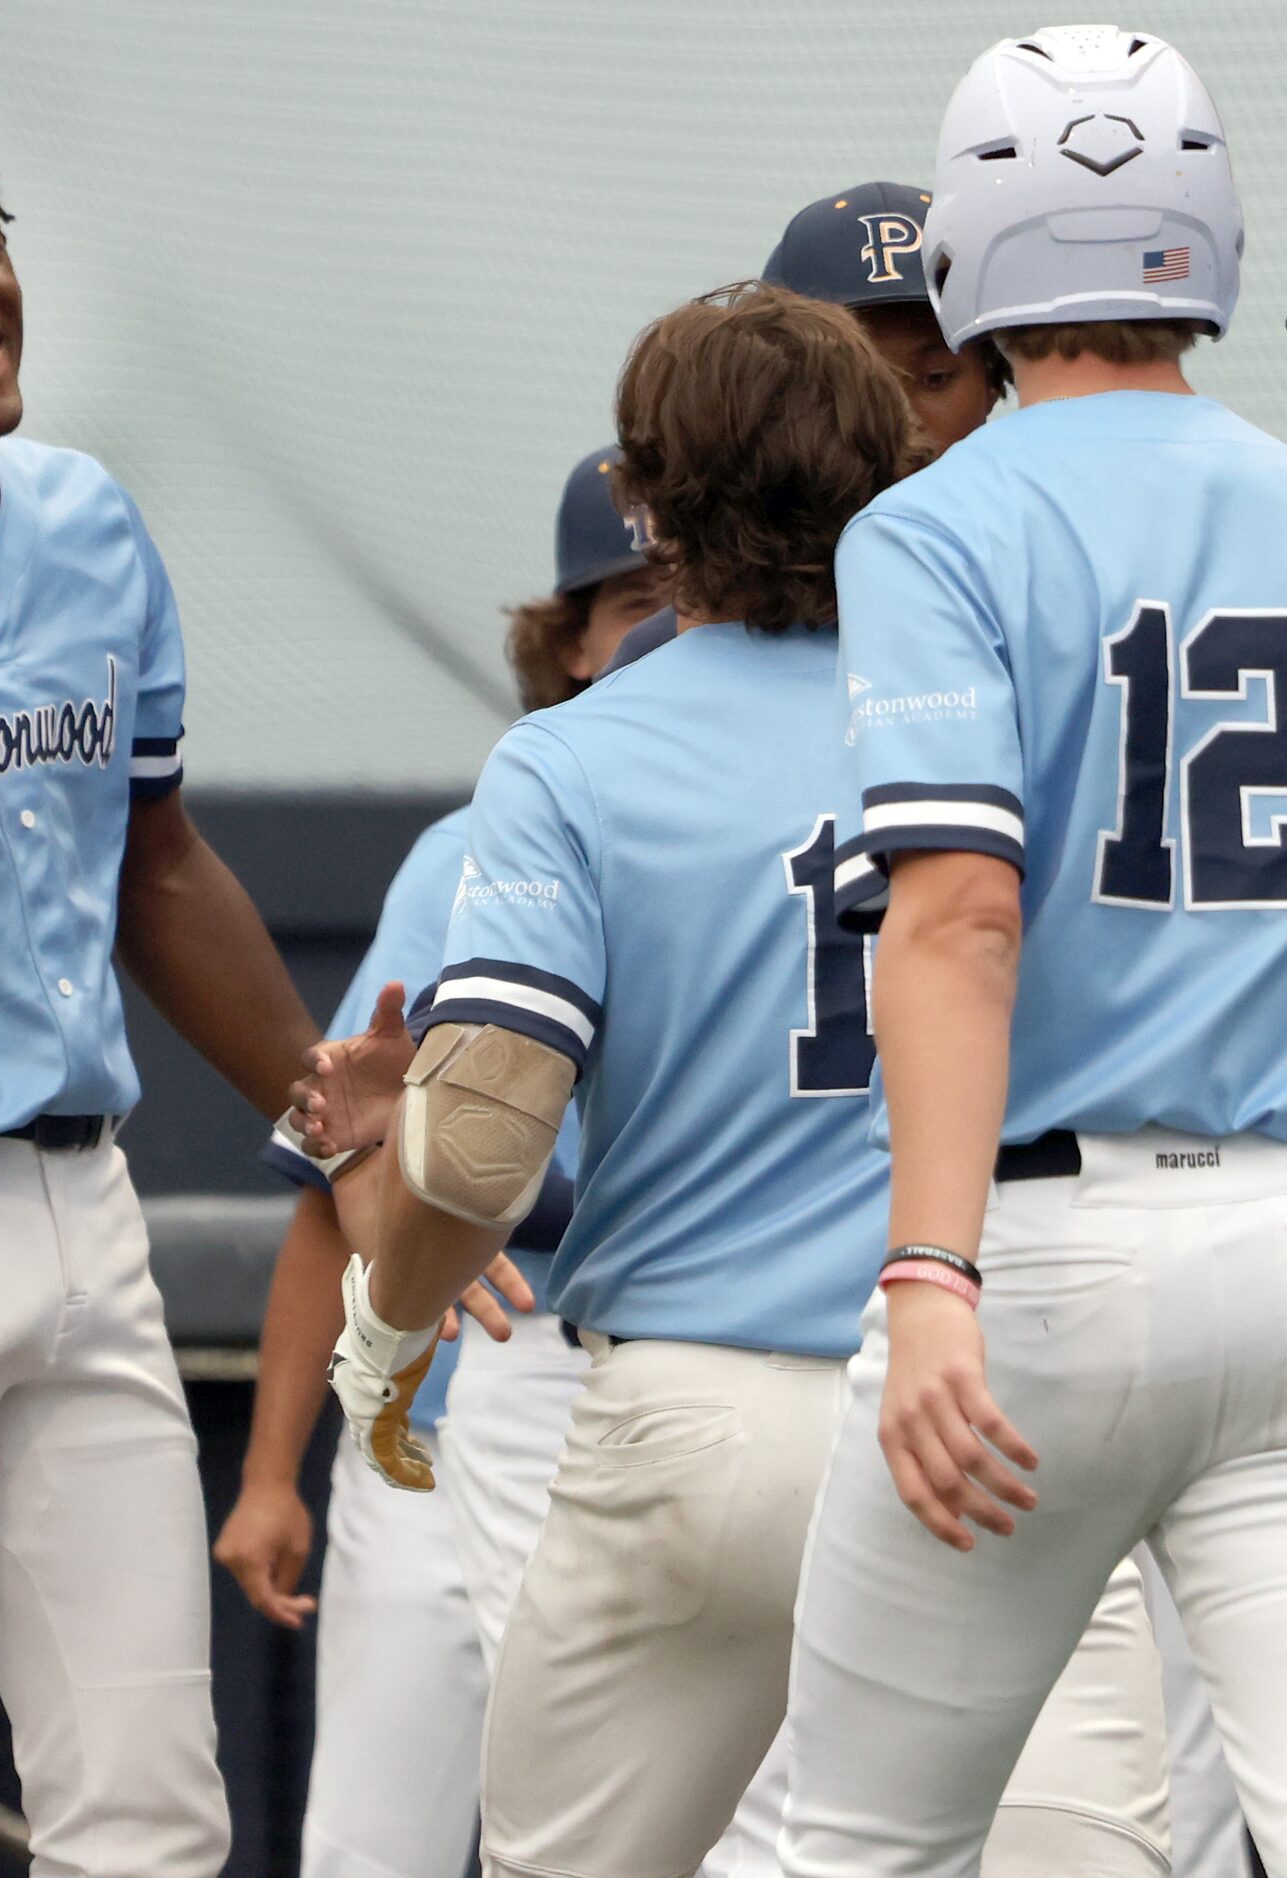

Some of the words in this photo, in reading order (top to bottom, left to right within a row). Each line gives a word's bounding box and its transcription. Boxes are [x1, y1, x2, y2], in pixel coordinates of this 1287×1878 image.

[857, 211, 923, 283] P
[854, 686, 977, 720] stonwood
[1091, 598, 1287, 911] 12
[1155, 1144, 1221, 1169] marucci
[916, 1263, 951, 1284] GOD
